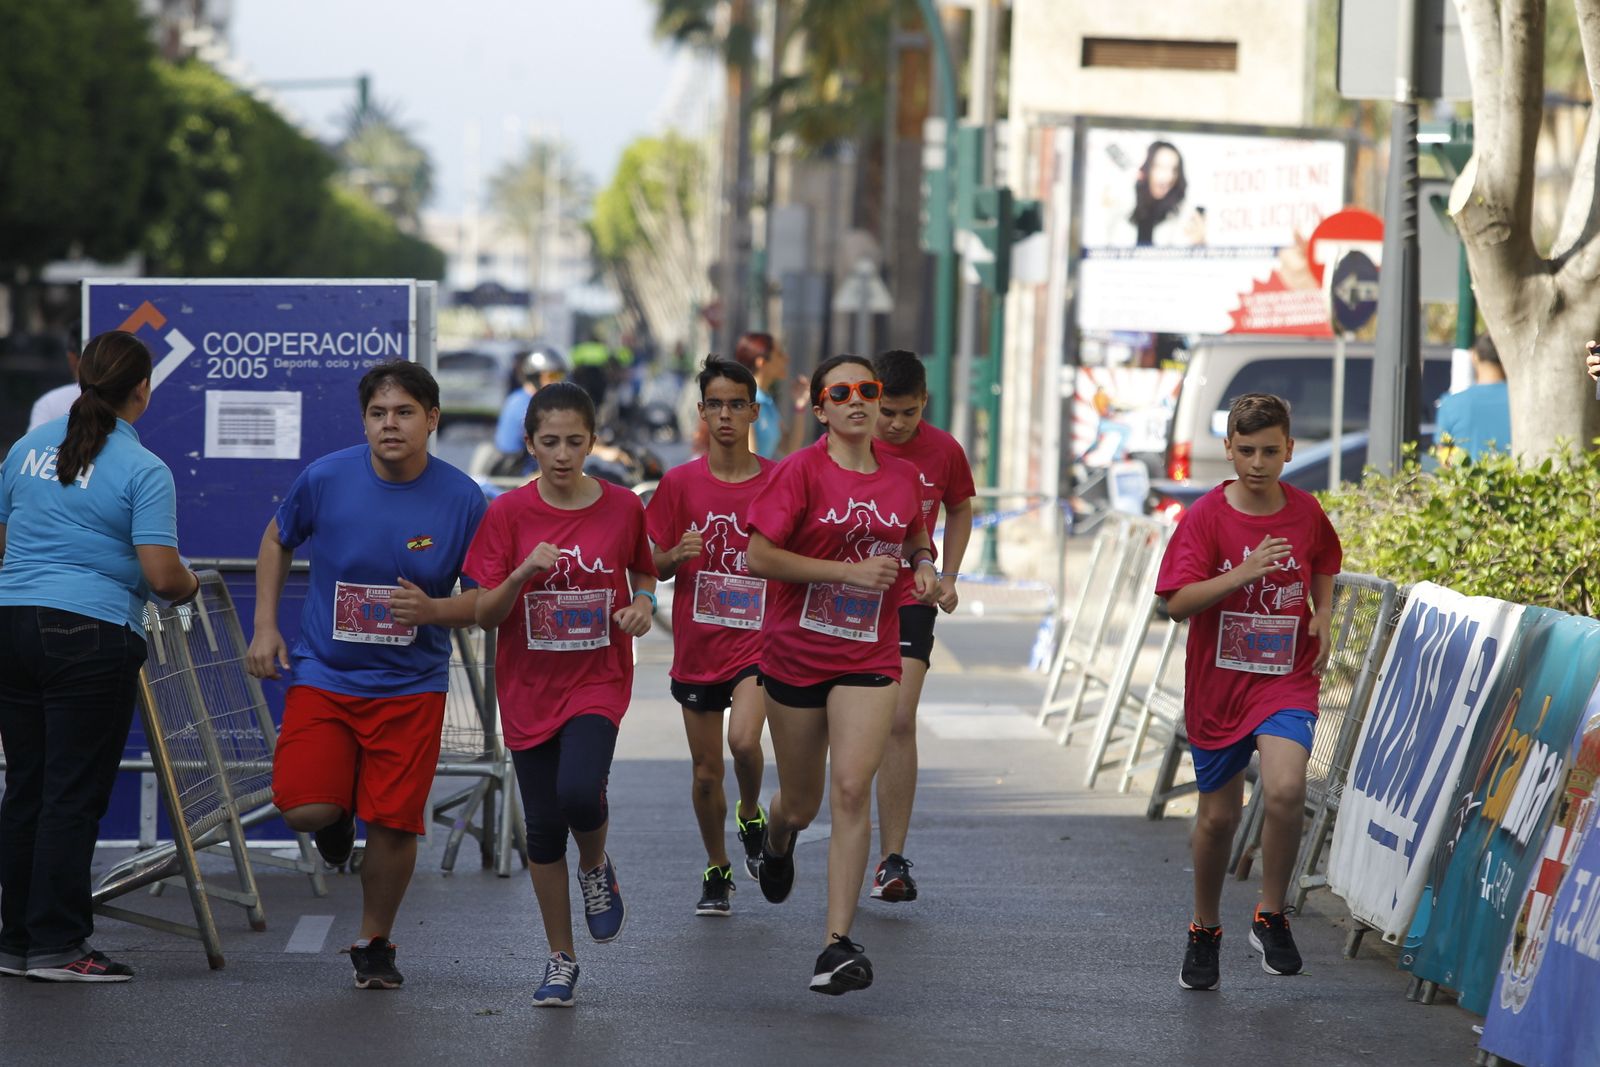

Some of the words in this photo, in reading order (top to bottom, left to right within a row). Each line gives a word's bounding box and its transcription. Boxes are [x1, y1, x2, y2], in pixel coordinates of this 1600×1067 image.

[203, 327, 402, 356] COOPERACIÓN
[206, 357, 268, 379] 2005
[325, 358, 349, 368] ocio
[352, 359, 359, 370] y
[20, 448, 94, 489] NEA
[834, 595, 880, 617] 1837
[554, 607, 604, 628] 1791
[1244, 632, 1294, 651] 1587
